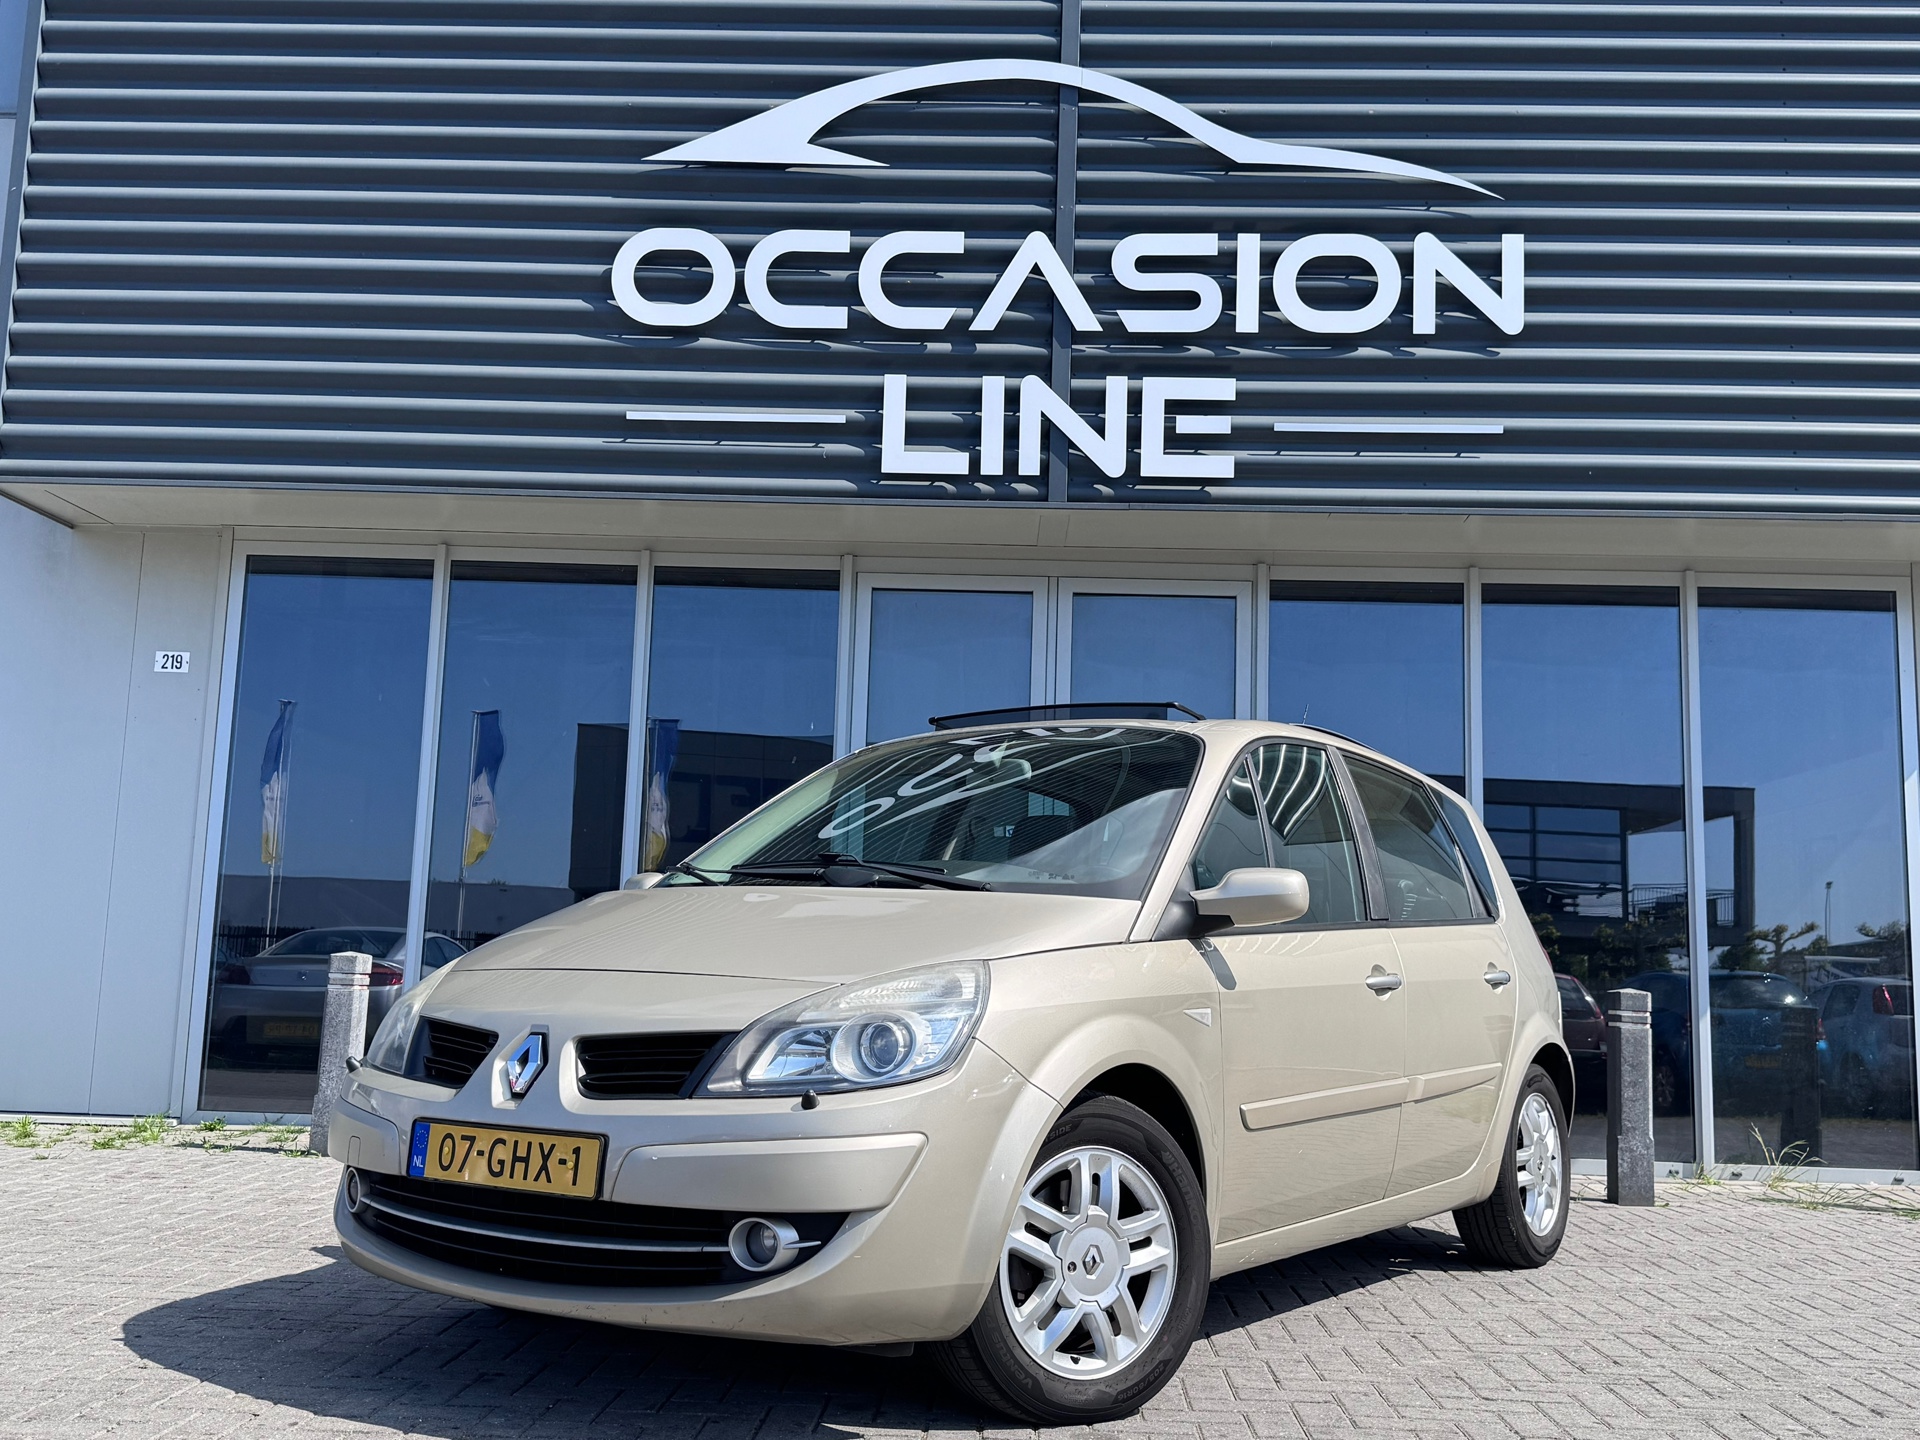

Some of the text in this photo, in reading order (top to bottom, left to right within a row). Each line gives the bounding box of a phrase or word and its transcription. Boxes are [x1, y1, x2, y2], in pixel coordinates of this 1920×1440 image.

[611, 227, 1525, 336] OCCASION
[881, 374, 1236, 479] LINE
[161, 653, 183, 670] 219
[412, 1154, 424, 1168] NL
[438, 1132, 581, 1187] 07-GHX-1
